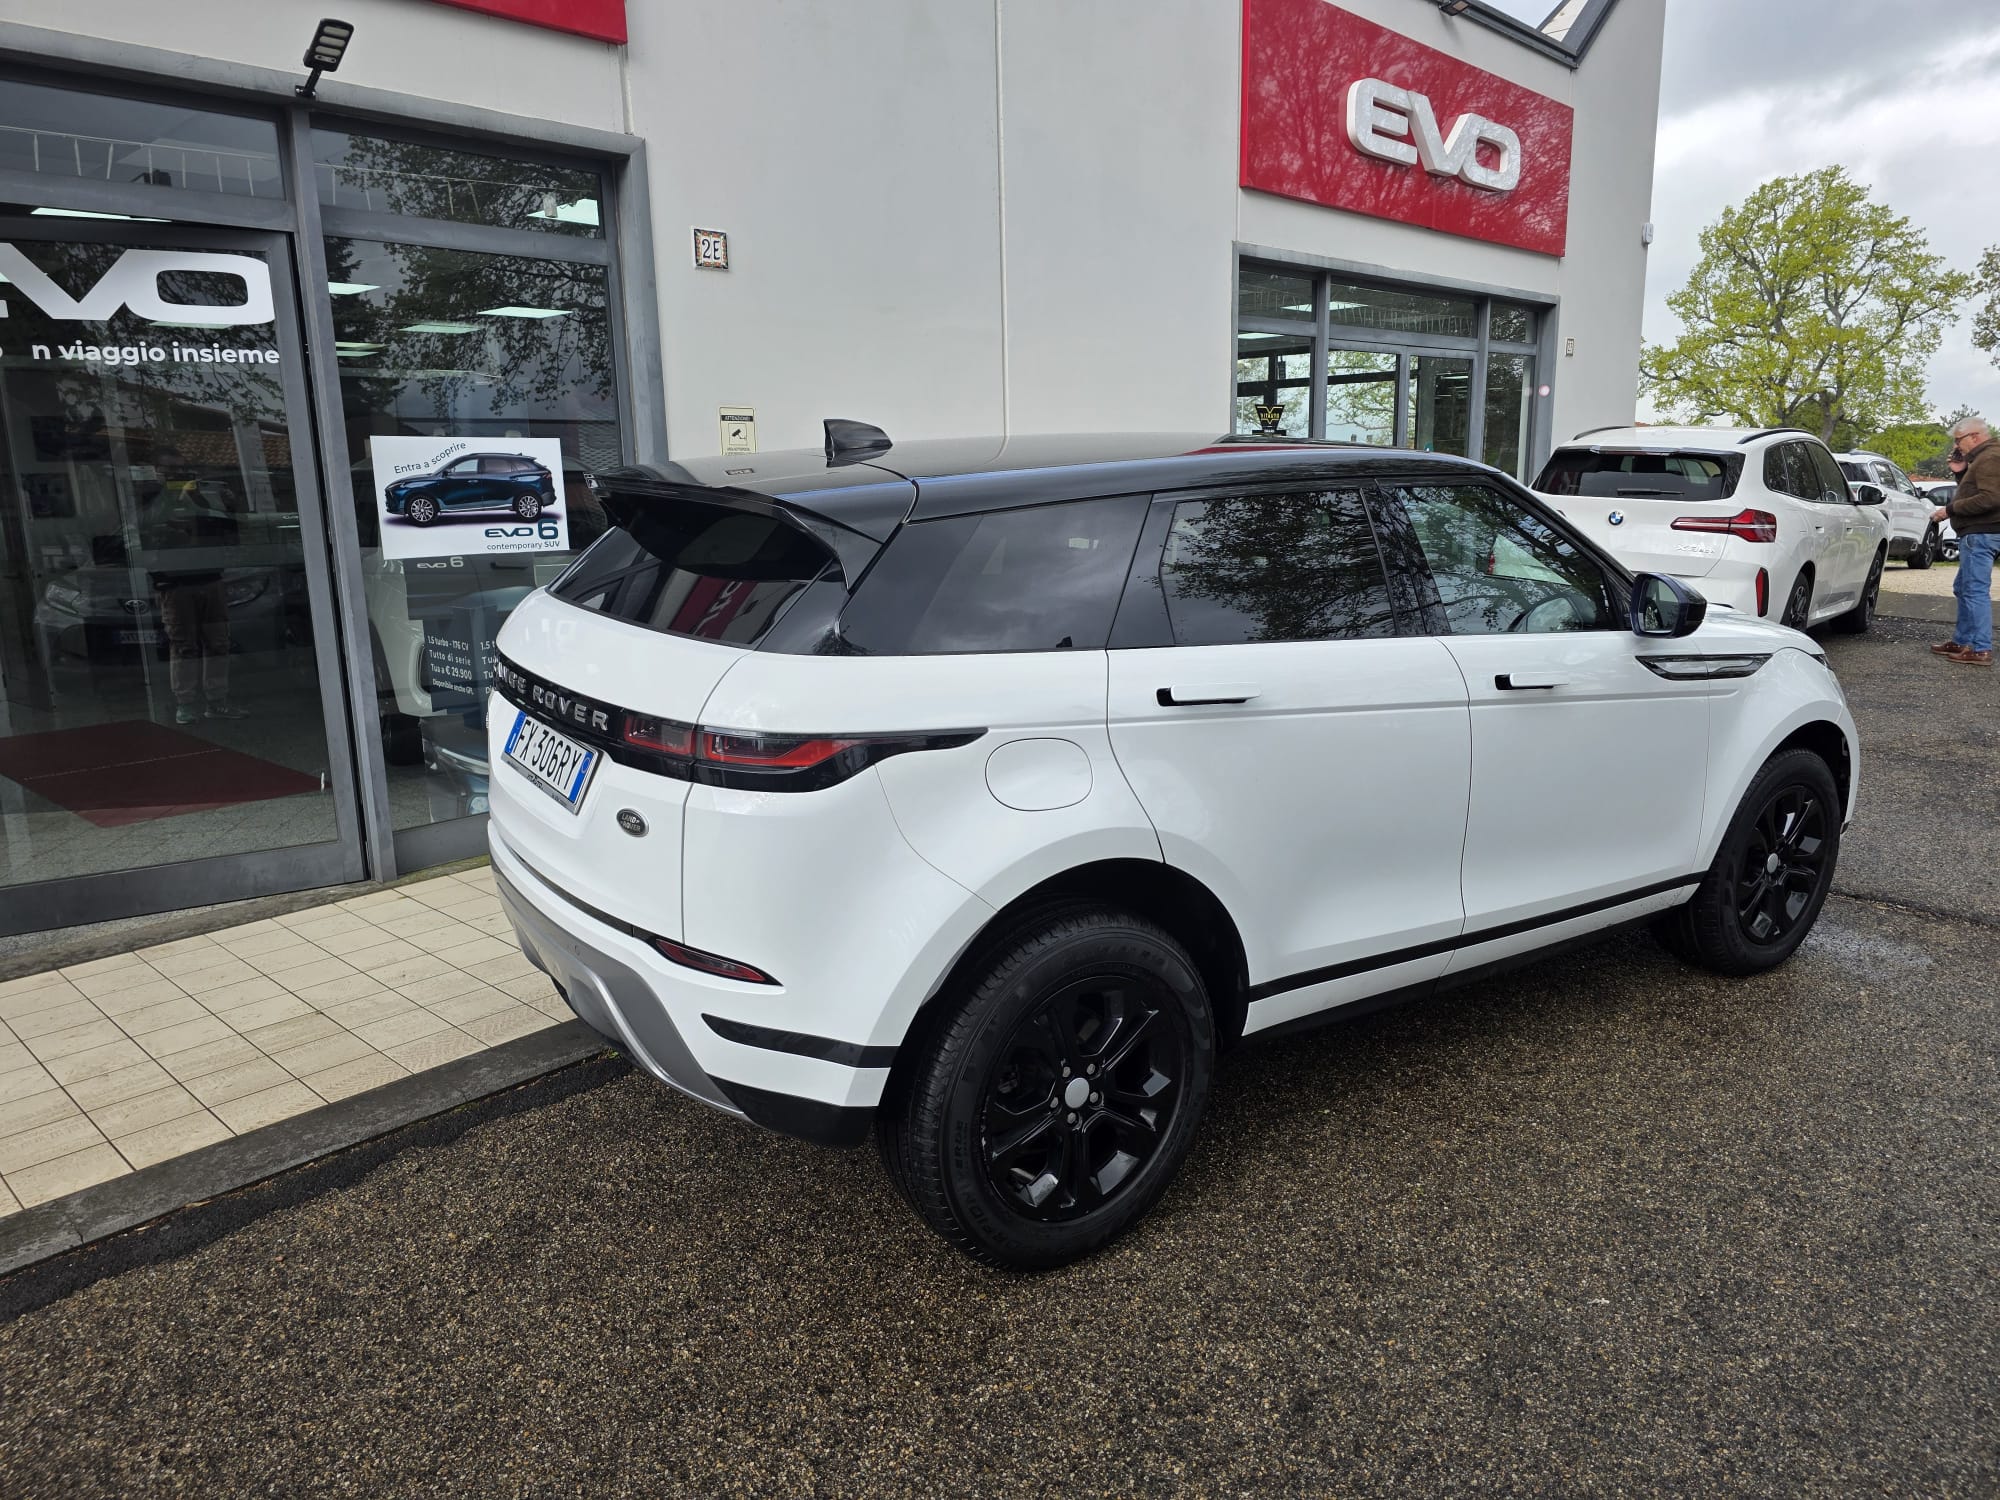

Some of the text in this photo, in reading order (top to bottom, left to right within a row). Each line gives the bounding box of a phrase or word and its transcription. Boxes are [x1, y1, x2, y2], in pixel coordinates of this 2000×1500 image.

[1346, 78, 1521, 193] EVO
[0, 242, 275, 326] VO
[58, 339, 166, 366] viaggio
[172, 341, 281, 364] insieme
[394, 441, 467, 474] Entra a scoprire
[485, 518, 559, 540] EVO 6
[486, 540, 560, 551] contemporary SUV
[416, 556, 464, 569] EVO 6
[428, 649, 446, 661] Tutto
[447, 652, 454, 662] di
[455, 656, 471, 666] serie
[532, 684, 609, 731] ROVER
